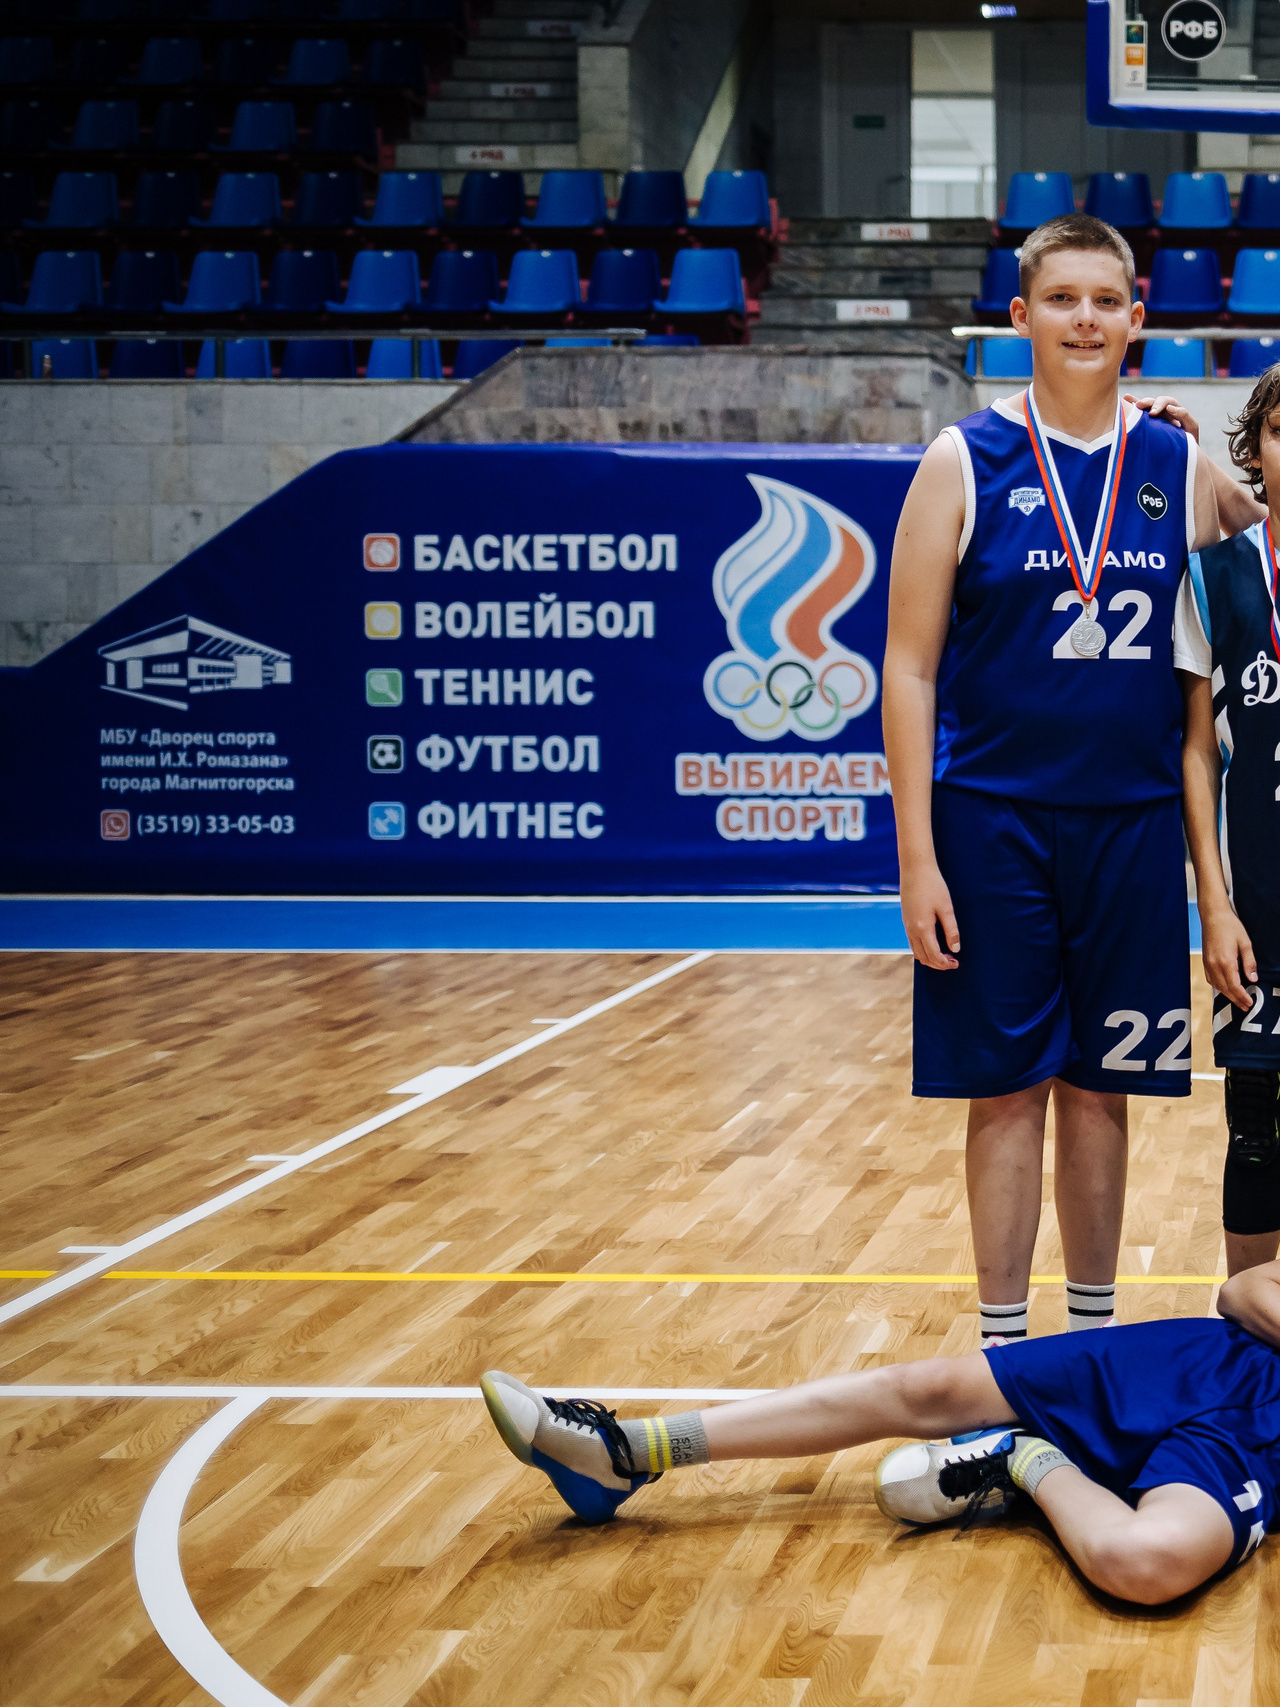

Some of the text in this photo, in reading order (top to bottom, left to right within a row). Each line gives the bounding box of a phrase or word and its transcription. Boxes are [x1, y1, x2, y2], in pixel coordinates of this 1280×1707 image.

[1169, 20, 1218, 39] РФБ
[1014, 497, 1041, 505] ДИНАМО
[1142, 494, 1163, 508] РФБ
[413, 534, 678, 571] БАСКЕТБОЛ
[1024, 550, 1166, 570] ДИАМО
[415, 592, 655, 639] ВОЛЕЙБОЛ
[1052, 589, 1153, 660] 22
[414, 668, 595, 706] ТЕННИС
[100, 728, 277, 749] МБУ «Дворец спорта
[101, 751, 289, 768] имени И.Х. Ромазана»
[416, 734, 600, 772] ФУТБОЛ
[101, 774, 295, 795] города Магнитогорска
[136, 815, 295, 836] (3519) 33-05-03
[417, 801, 605, 839] ФИТНЕС
[720, 802, 862, 837] СПОРТ!
[1101, 1008, 1192, 1072] 22
